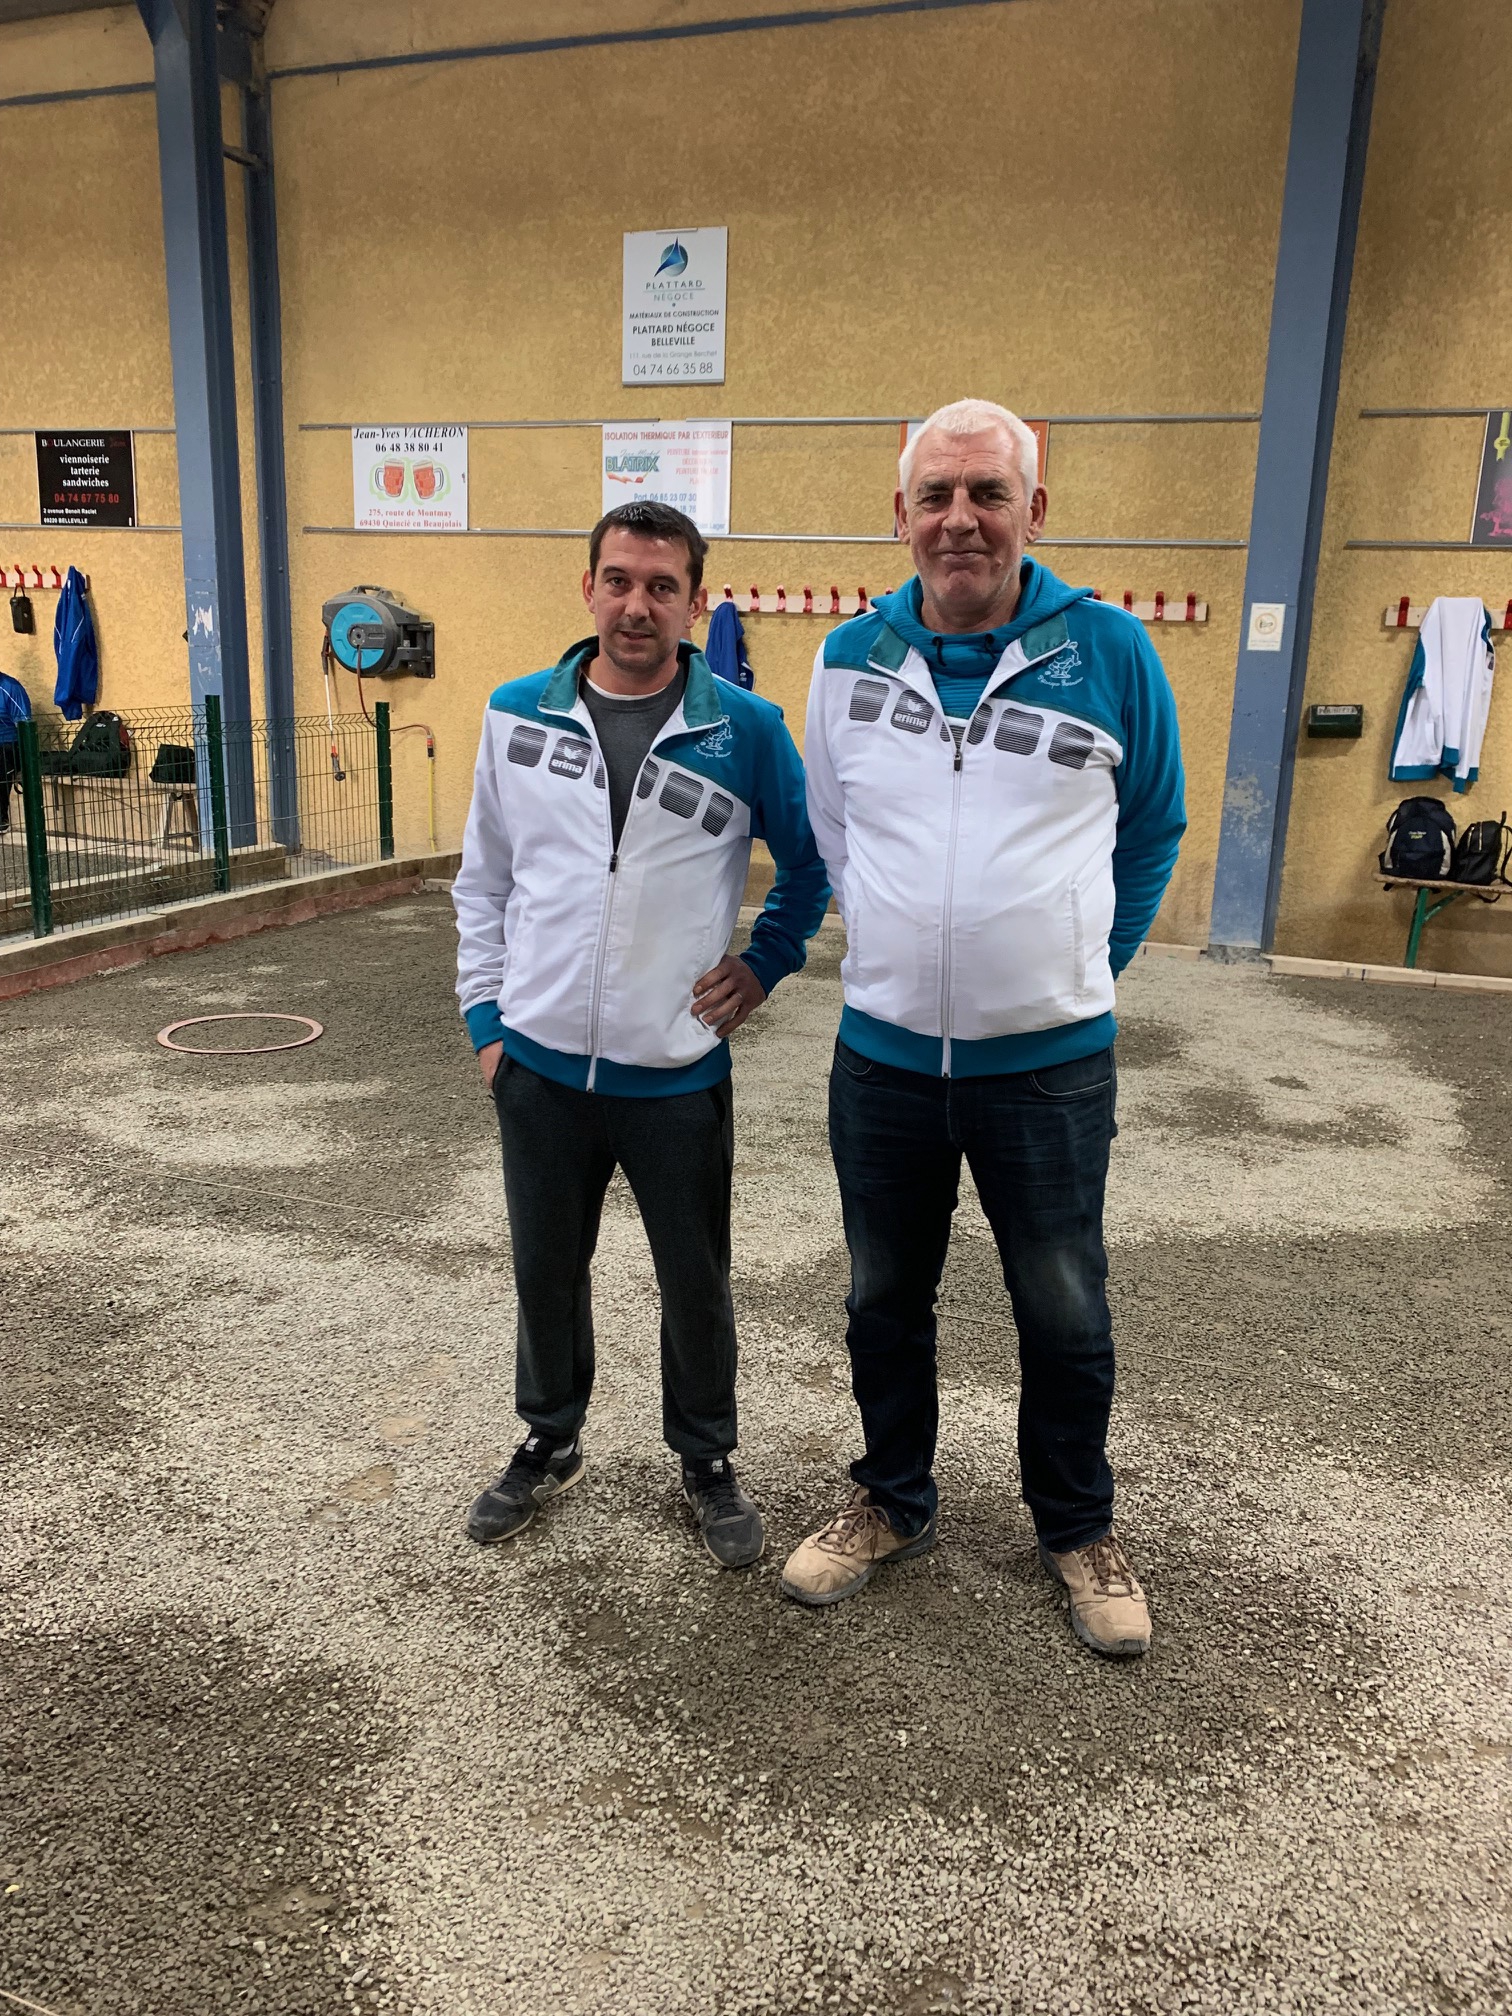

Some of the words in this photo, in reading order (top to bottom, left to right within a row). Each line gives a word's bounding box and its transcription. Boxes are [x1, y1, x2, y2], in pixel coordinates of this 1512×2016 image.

[646, 280, 703, 290] PLATTARD
[629, 311, 662, 319] MATÉRIAUX
[672, 309, 719, 317] CONSTRUCTION
[632, 324, 674, 334] PLATTARD
[676, 321, 715, 332] NÉGOCE
[651, 336, 695, 346] BELLEVILLE
[633, 364, 647, 376] 04
[650, 363, 663, 375] 74
[666, 363, 680, 375] 66
[683, 362, 696, 374] 35
[699, 362, 713, 374] 88
[353, 427, 400, 439] Jean-Yves
[403, 426, 465, 438] VACHERON
[604, 432, 638, 440] ISOLATION
[640, 431, 676, 440] THERMIQUE
[678, 431, 690, 440] PAR
[375, 443, 387, 453] 06
[390, 443, 401, 452] 48
[404, 442, 415, 452] 38
[418, 442, 430, 452] 80
[432, 442, 443, 452] 41
[59, 454, 110, 464] viennoiserie
[605, 456, 660, 472] BLATRIX
[70, 466, 100, 475] tarterie
[62, 477, 109, 487] sandwiches
[54, 493, 65, 503] 04
[67, 493, 78, 503] 74
[81, 493, 92, 503] 67
[94, 494, 106, 504] 75
[108, 494, 119, 504] 80
[649, 493, 659, 501] 06
[669, 493, 678, 501] 23
[679, 493, 687, 501] 07
[385, 509, 405, 517] route
[406, 509, 416, 517] de
[418, 509, 452, 518] Montmay
[359, 519, 380, 527] 69430
[423, 519, 462, 529] Beaujolais
[893, 712, 928, 728] erima
[551, 758, 583, 774] erima
